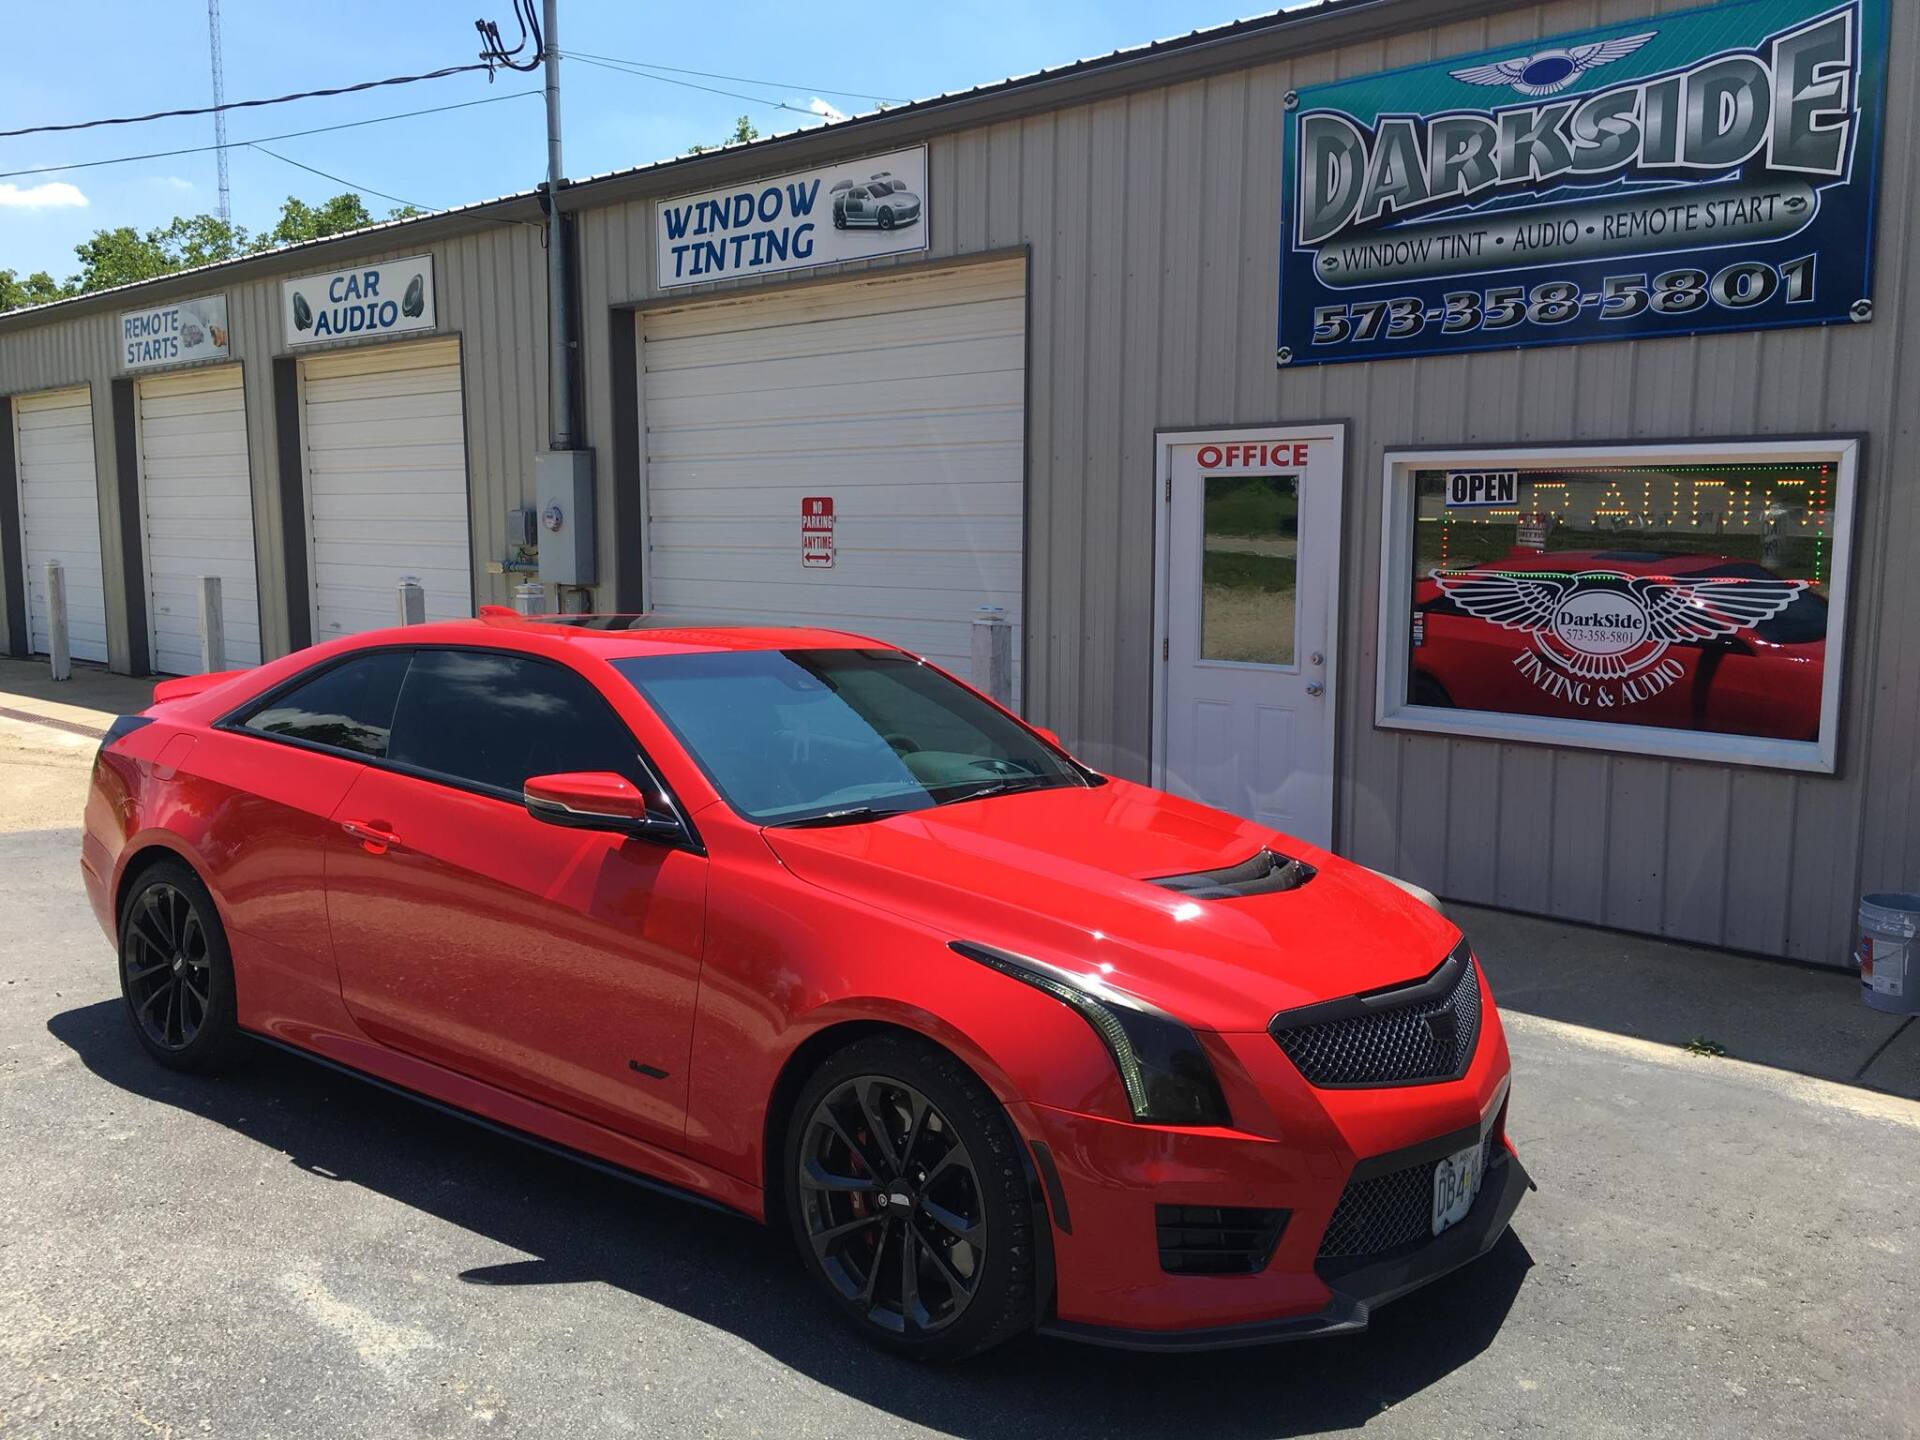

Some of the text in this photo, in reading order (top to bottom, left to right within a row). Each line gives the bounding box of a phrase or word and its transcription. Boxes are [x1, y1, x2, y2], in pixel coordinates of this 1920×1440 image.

[1299, 8, 1855, 247] DARKSIDE
[663, 179, 821, 240] WINDOW
[1342, 193, 1782, 273] WINDOW TINT AUDIO REMOTE START
[671, 223, 815, 277] TINTING
[329, 270, 380, 303] CAR
[1311, 254, 1817, 346] 573-358-5801
[124, 309, 179, 340] REMOTE
[314, 300, 399, 337] AUDIO
[127, 336, 179, 364] STARTS
[1196, 444, 1309, 469] OFFICE
[1452, 473, 1514, 502] OPEN
[802, 516, 833, 529] PARKING
[812, 501, 823, 515] NO
[1560, 611, 1642, 630] DarkSide
[1566, 629, 1634, 643] 573-358-5801
[1512, 646, 1685, 707] TINTING & AUDIO
